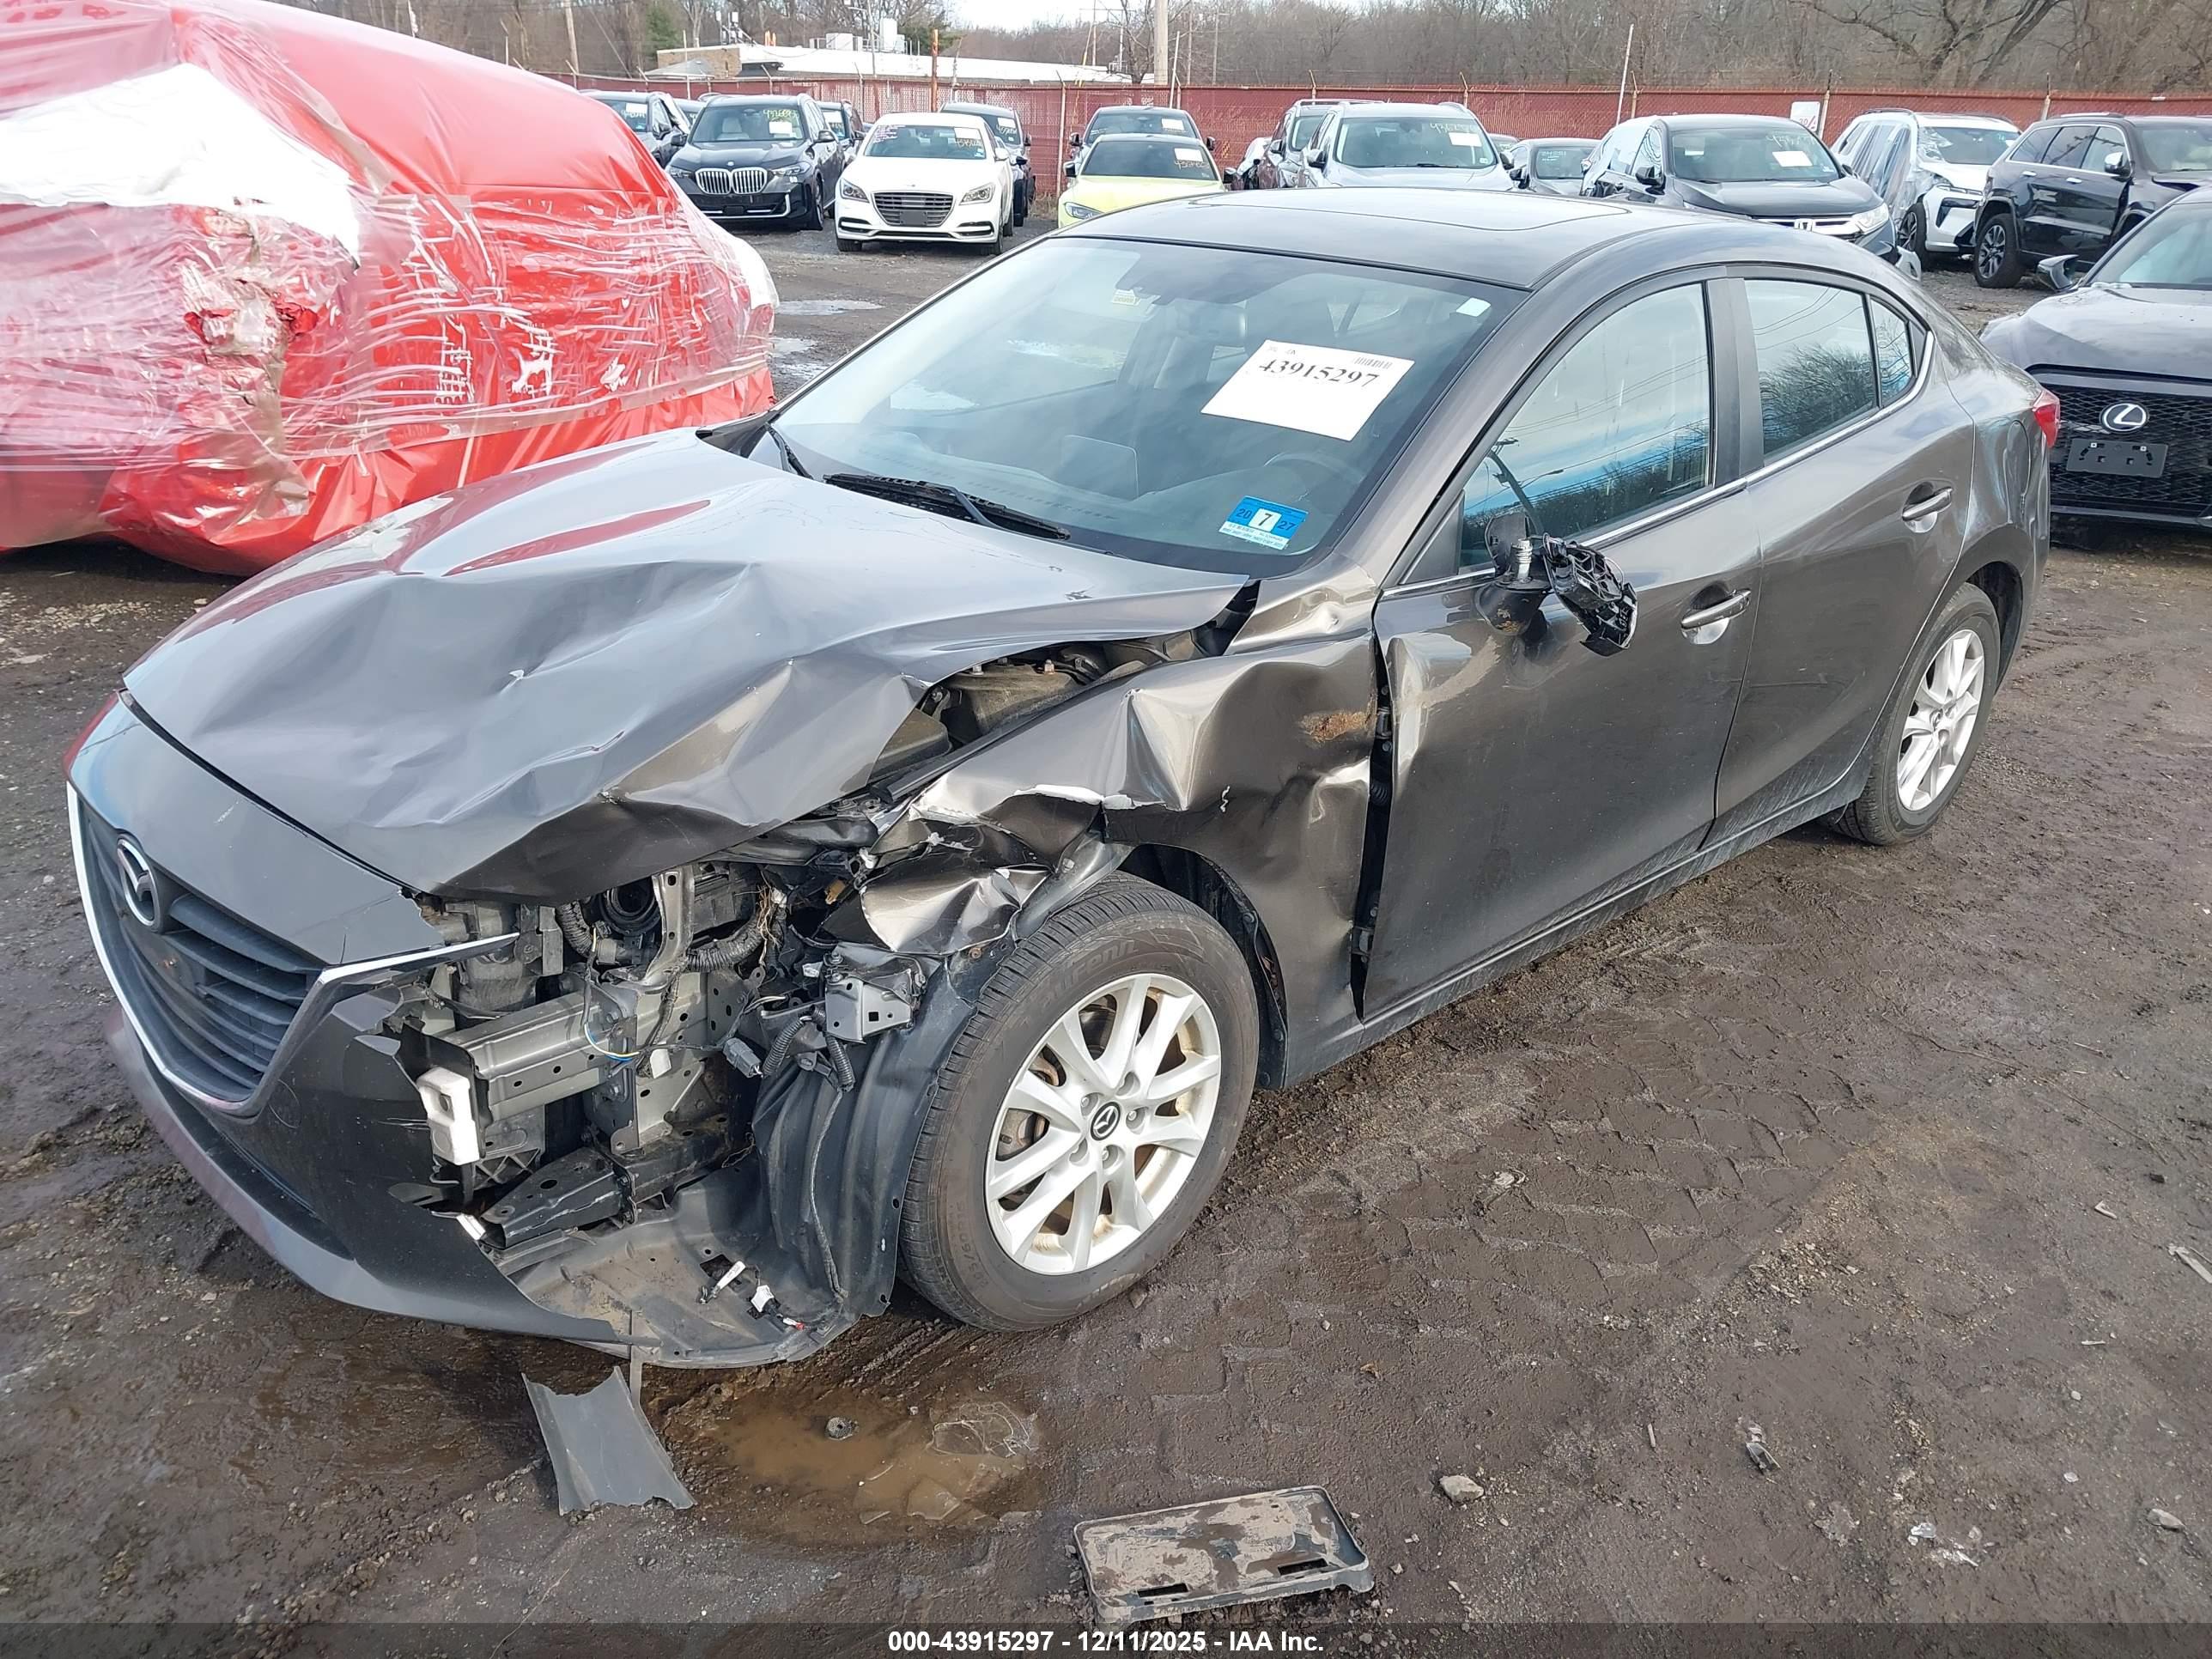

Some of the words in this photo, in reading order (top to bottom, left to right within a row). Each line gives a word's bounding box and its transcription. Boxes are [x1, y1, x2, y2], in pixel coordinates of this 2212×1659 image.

[1259, 359, 1380, 388] 43915297
[1236, 508, 1253, 520] 20
[1258, 513, 1273, 526] 7
[1277, 520, 1296, 531] 27
